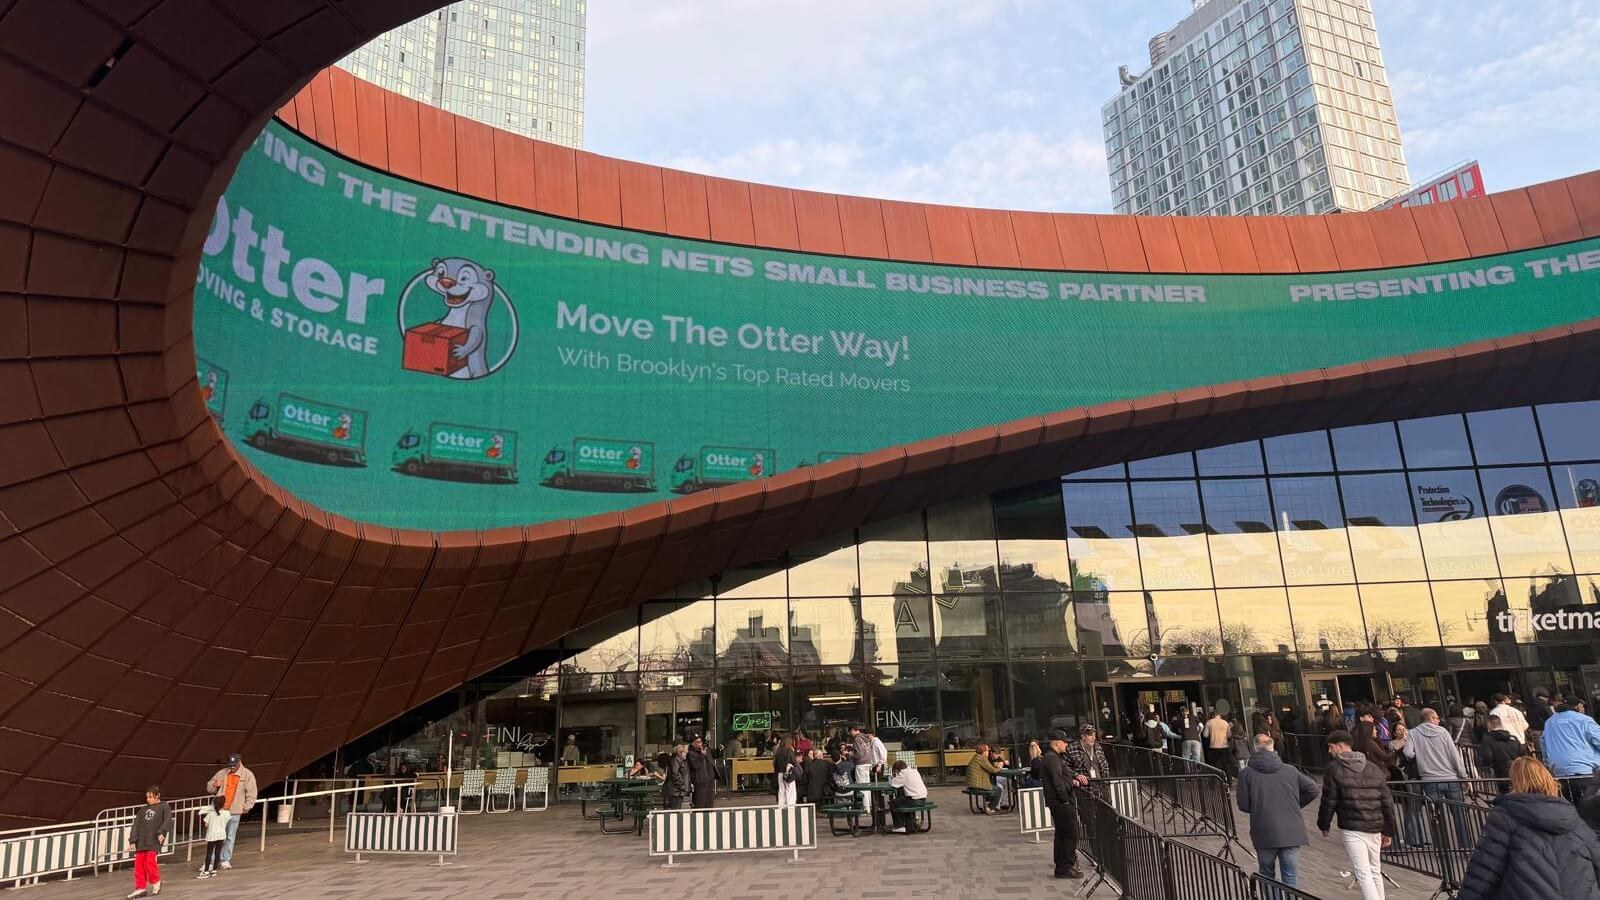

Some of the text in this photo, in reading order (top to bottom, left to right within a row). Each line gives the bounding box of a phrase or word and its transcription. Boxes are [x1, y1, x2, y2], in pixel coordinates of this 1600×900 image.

[255, 128, 1207, 303] ING THE ATTENDING NETS SMALL BUSINESS PARTNER
[1289, 249, 1600, 303] PRESENTING THE
[251, 298, 264, 321] &
[270, 307, 378, 355] STORAGE
[557, 301, 910, 367] Move The Otter Way!
[558, 346, 911, 392] With Brooklyn's Top Rated Movers
[284, 404, 331, 426] Otter
[436, 431, 484, 448] Otter
[580, 445, 624, 460] Otter
[706, 453, 746, 467] Otter
[1418, 485, 1450, 494] Protection
[1420, 497, 1459, 507] Technologies
[735, 714, 771, 730] Open
[876, 710, 906, 727] FINI
[486, 726, 521, 743] FINI
